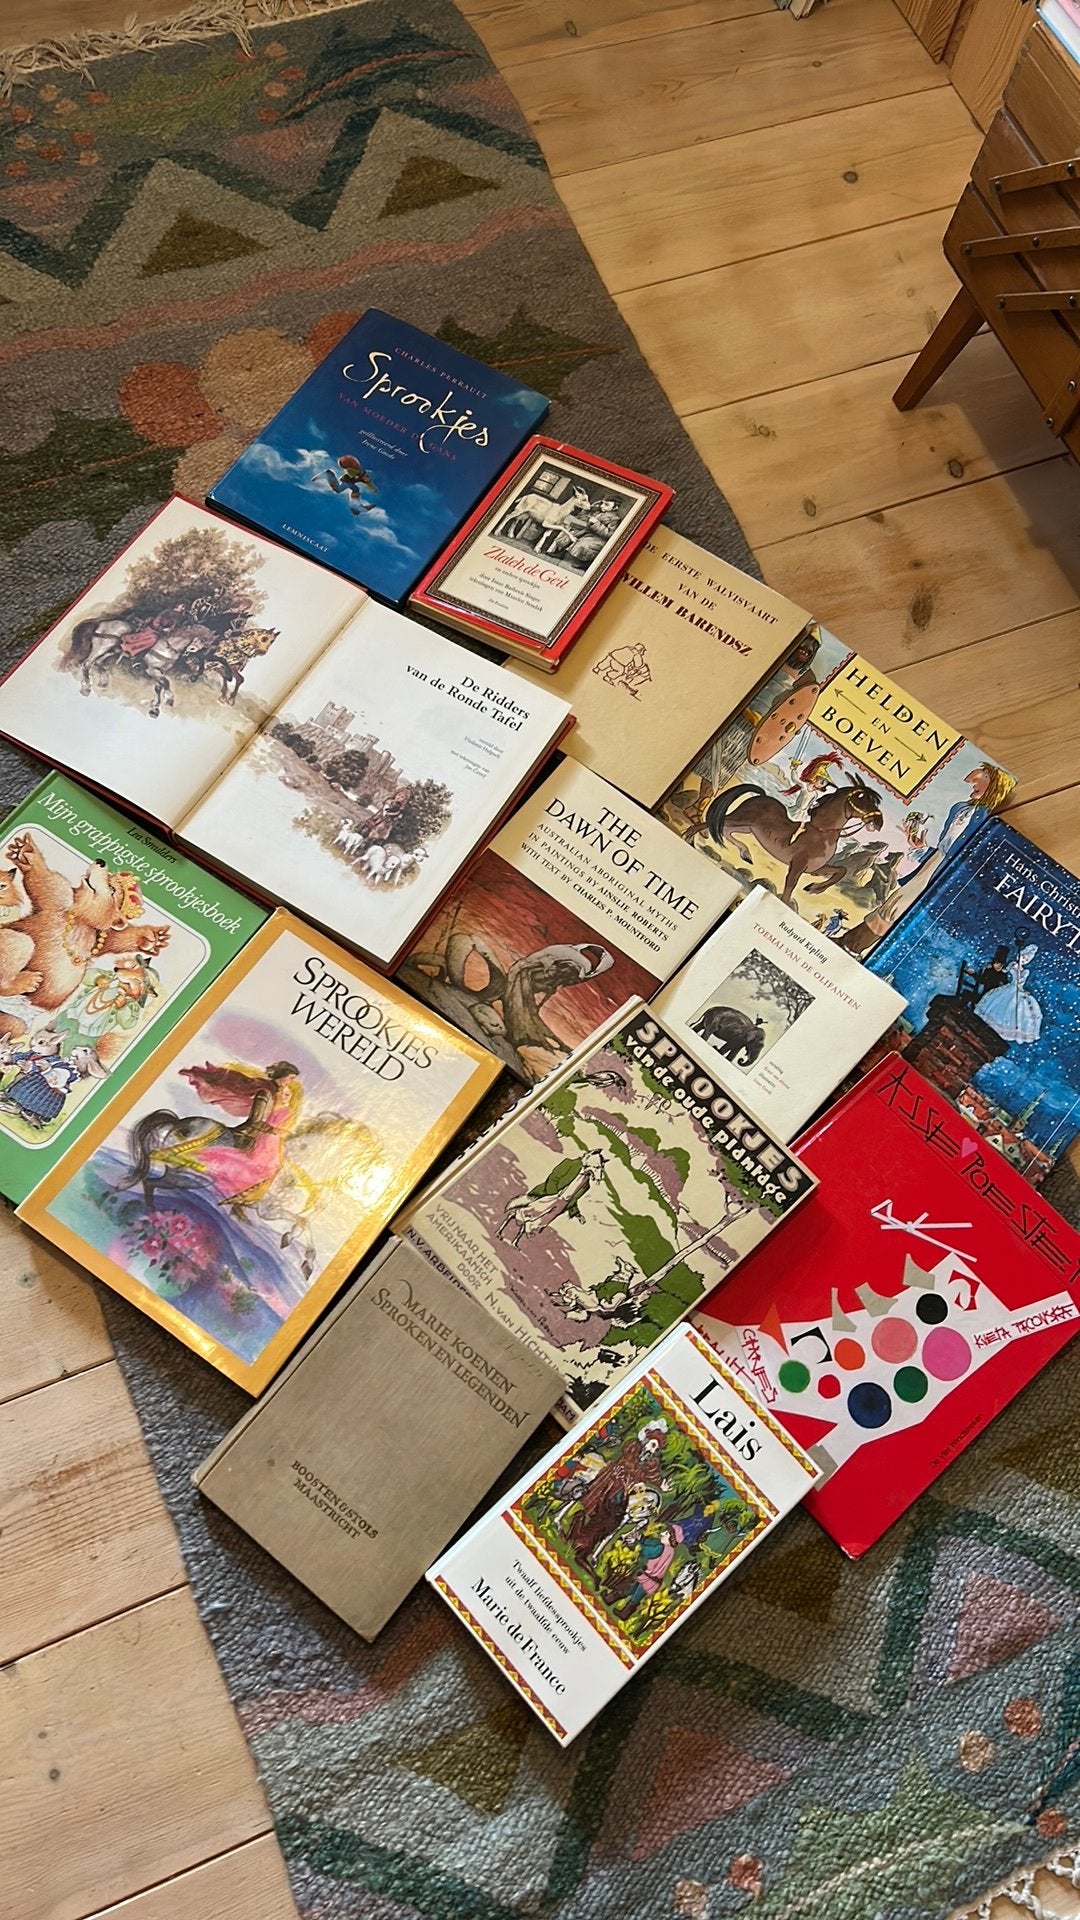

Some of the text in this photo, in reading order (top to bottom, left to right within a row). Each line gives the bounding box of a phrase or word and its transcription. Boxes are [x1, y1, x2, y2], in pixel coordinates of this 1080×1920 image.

[342, 352, 489, 454] Sprookjes
[394, 348, 487, 399] CHARLES PERRAULT
[338, 392, 359, 408] VAN
[362, 406, 408, 434] MOEDER
[428, 442, 457, 461] GANS
[483, 545, 570, 590] Zlateh de Geit
[661, 552, 702, 580] EERSTE
[706, 578, 779, 625] WALVISVAART
[678, 583, 718, 612] VAN DE
[675, 606, 753, 657] BARENDSZ
[406, 664, 524, 732] van de Ronde Tafel
[460, 676, 530, 720] De Ridders
[846, 667, 950, 751] HELDEN
[871, 717, 892, 735] EN
[820, 706, 911, 780] BOEVEN
[37, 791, 243, 935] Mijn grappigste sprookjesboek
[127, 827, 178, 864] Lea Smulders
[544, 798, 700, 921] DAWN OF TIME
[598, 806, 642, 849] THE
[520, 842, 662, 953] WITH TEXT BY CHARLES P. MOUNTFORD
[528, 832, 670, 942] IN PAINTINGS BY AINSLIE ROBERTS
[537, 822, 678, 932] AUSTRALIAN ABORIGINAL MYTHS
[1005, 853, 1038, 884] Hans
[778, 920, 828, 964] Rudyard Kipling
[994, 872, 1080, 955] FAIRYT
[752, 922, 862, 1010] TOEMAI VAN DE OLIFANTEN
[290, 992, 405, 1082] WERELD
[293, 956, 439, 1069] SPROOKJES
[625, 1035, 655, 1068] van
[653, 1066, 674, 1088] de
[674, 1087, 714, 1130] oude
[711, 1129, 787, 1204] plantage
[636, 1021, 802, 1192] SPROOKJES
[406, 1228, 424, 1250] N.V.
[426, 1212, 493, 1286] AMERIKAANSCH
[436, 1204, 498, 1274] VRIJ NAAR HET
[457, 1262, 482, 1290] DOOR
[370, 1288, 437, 1352] SPROKEN
[434, 1347, 458, 1370] EN
[452, 1362, 532, 1428] LEGENDEN
[400, 1279, 452, 1342] MARIE
[450, 1336, 518, 1395] KOENEN
[688, 1374, 762, 1461] Lais
[291, 1460, 342, 1506] BOOSTEN
[345, 1508, 379, 1539] STOLS
[293, 1478, 361, 1540] MAASTRICHT
[470, 1577, 566, 1696] Marie de France
[504, 1576, 570, 1656] uit de twaalfde eeuw
[512, 1559, 588, 1652] Twaalf liefdessprookjes
